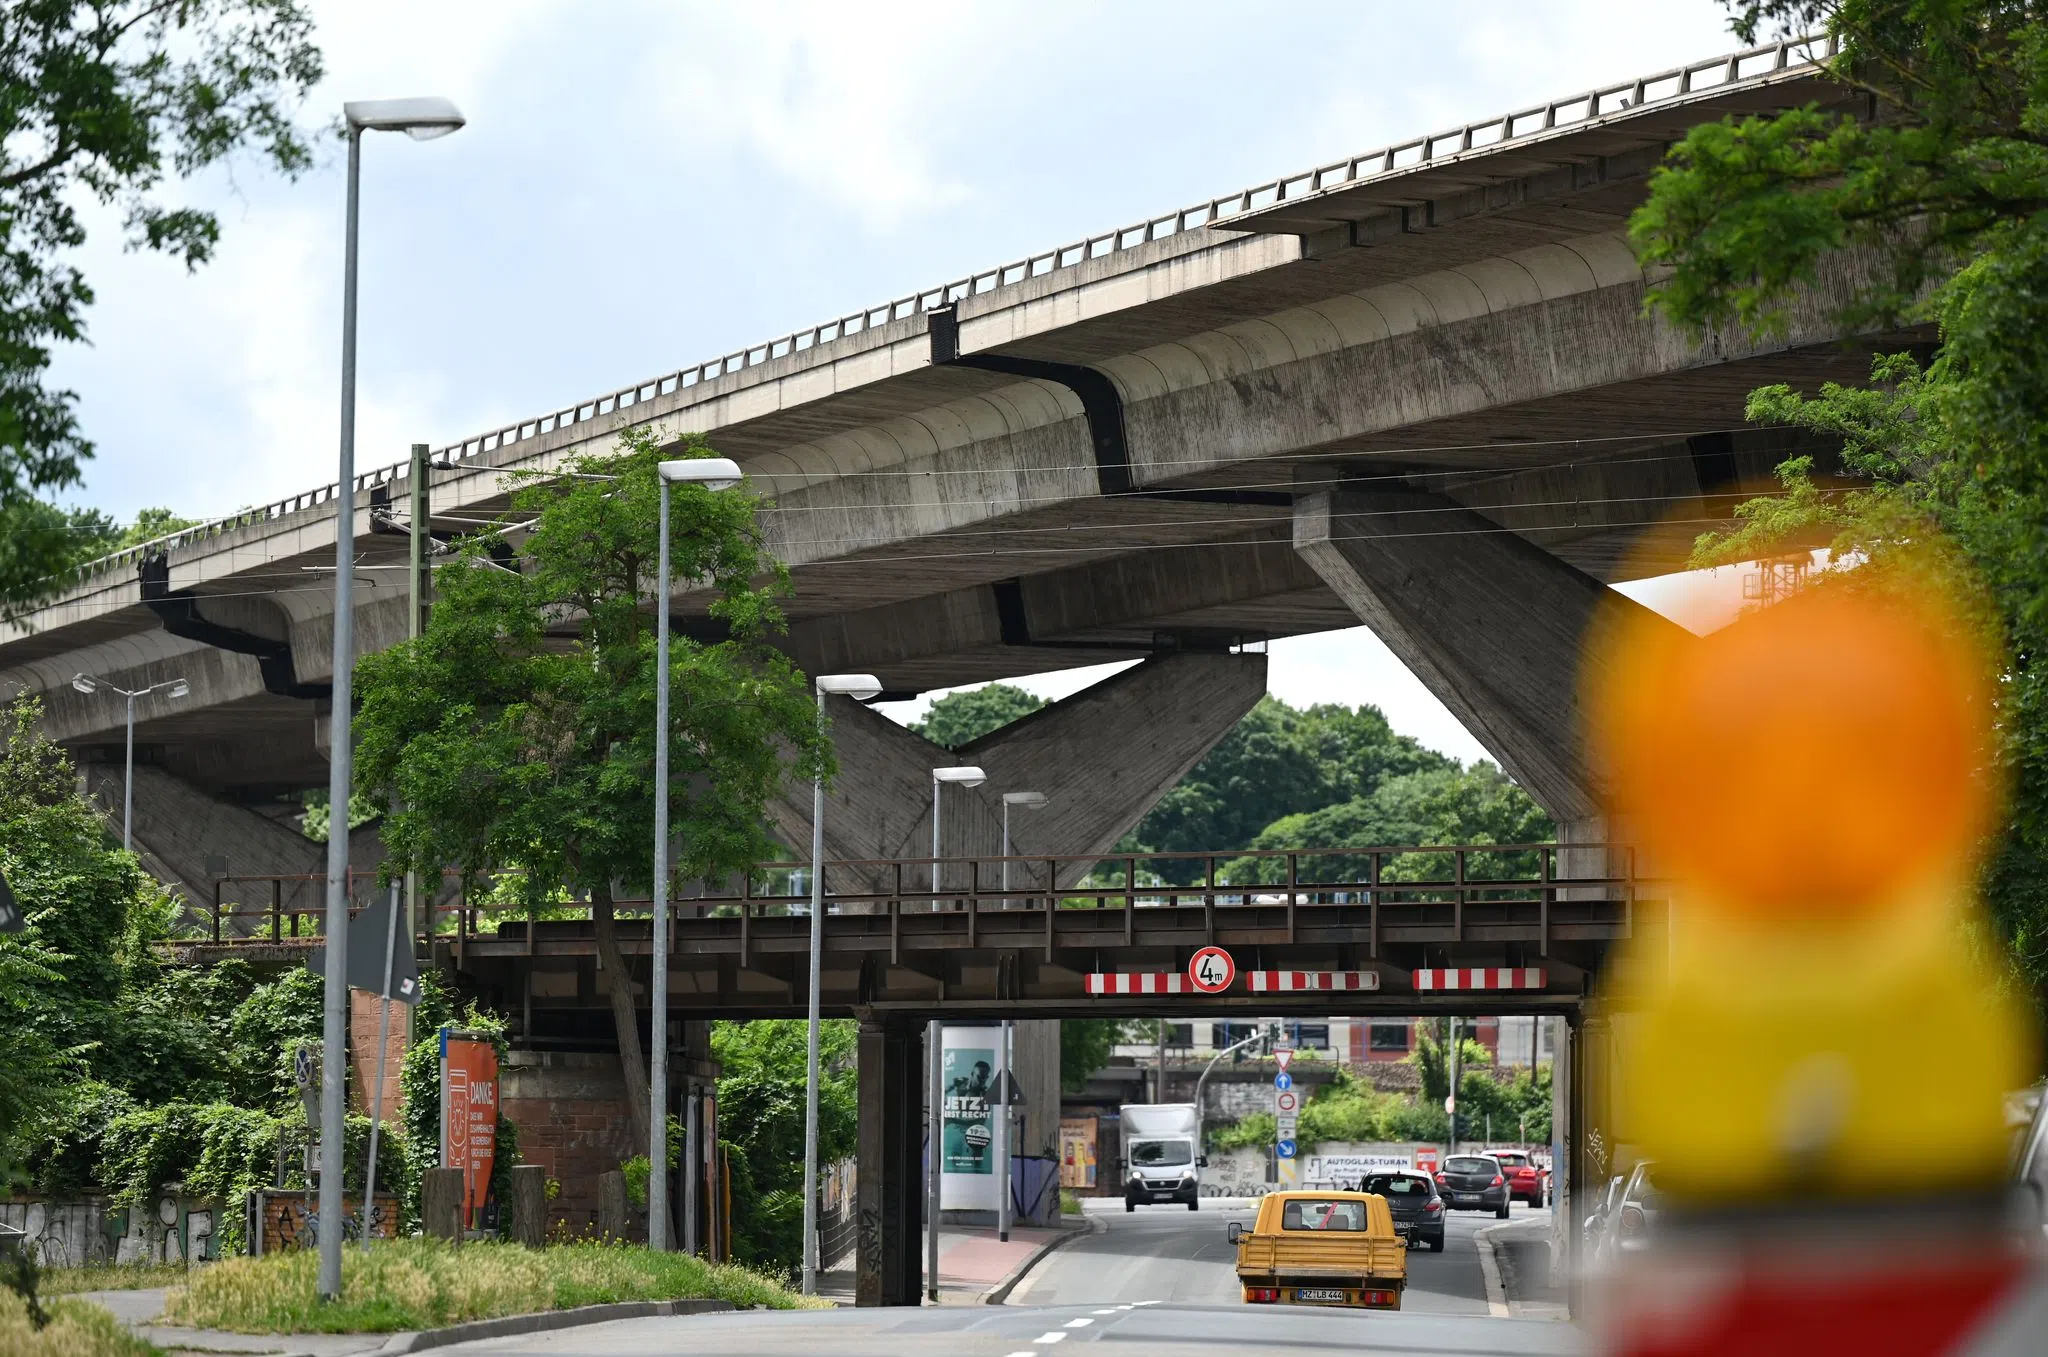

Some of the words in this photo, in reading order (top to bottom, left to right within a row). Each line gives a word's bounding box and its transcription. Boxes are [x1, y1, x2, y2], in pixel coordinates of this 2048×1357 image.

[962, 1111, 991, 1119] RECHT
[1326, 1157, 1408, 1166] AUTOGLAS-TURAN
[1316, 1290, 1327, 1299] LB
[1328, 1290, 1342, 1299] 444
